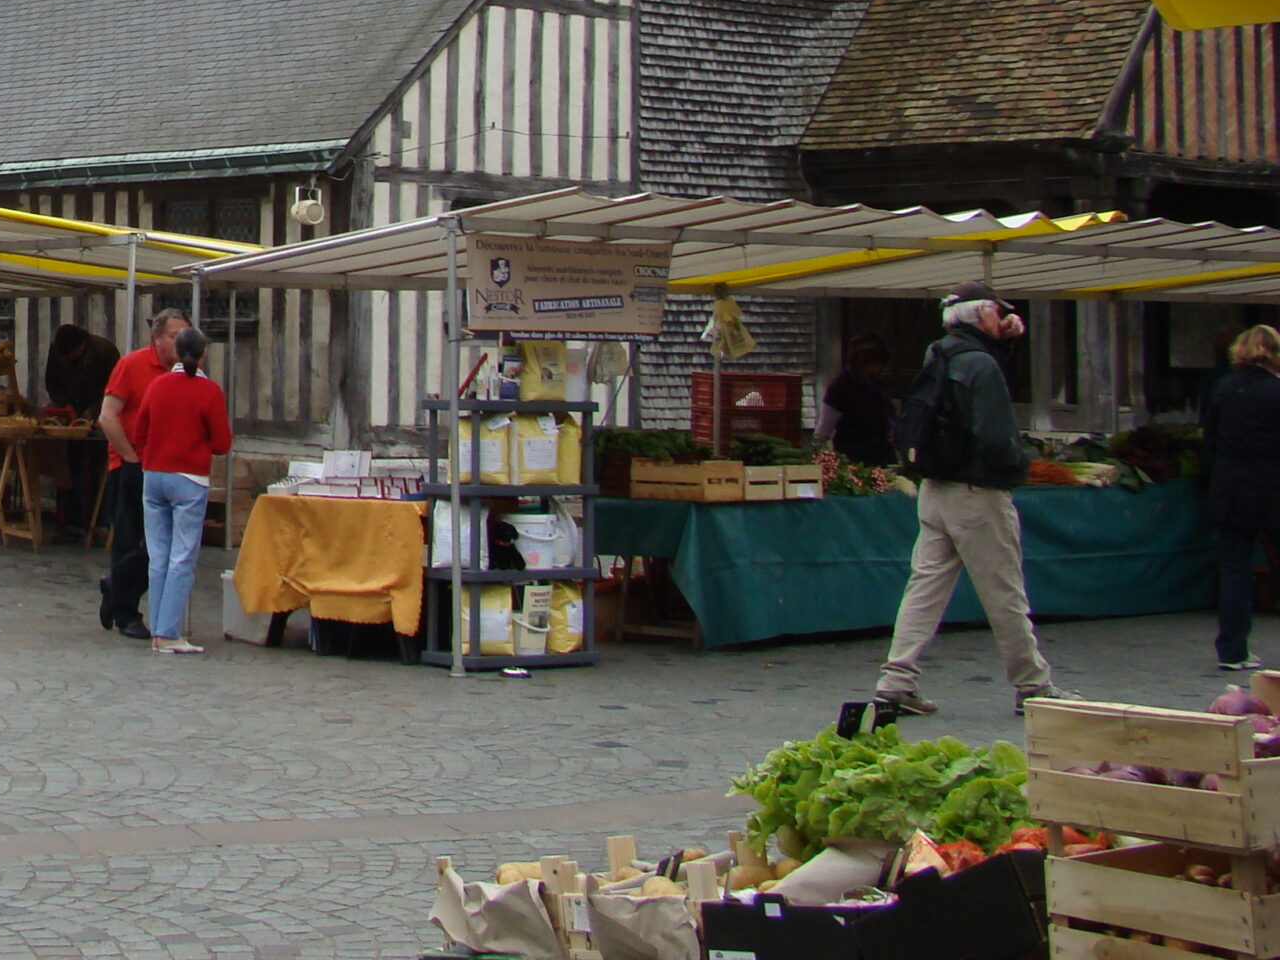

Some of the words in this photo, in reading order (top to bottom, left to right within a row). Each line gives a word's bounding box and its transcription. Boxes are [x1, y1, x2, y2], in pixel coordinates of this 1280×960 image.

[475, 288, 525, 305] NESTOR
[534, 300, 580, 311] FABRICATION
[581, 297, 622, 308] ARTISANALE
